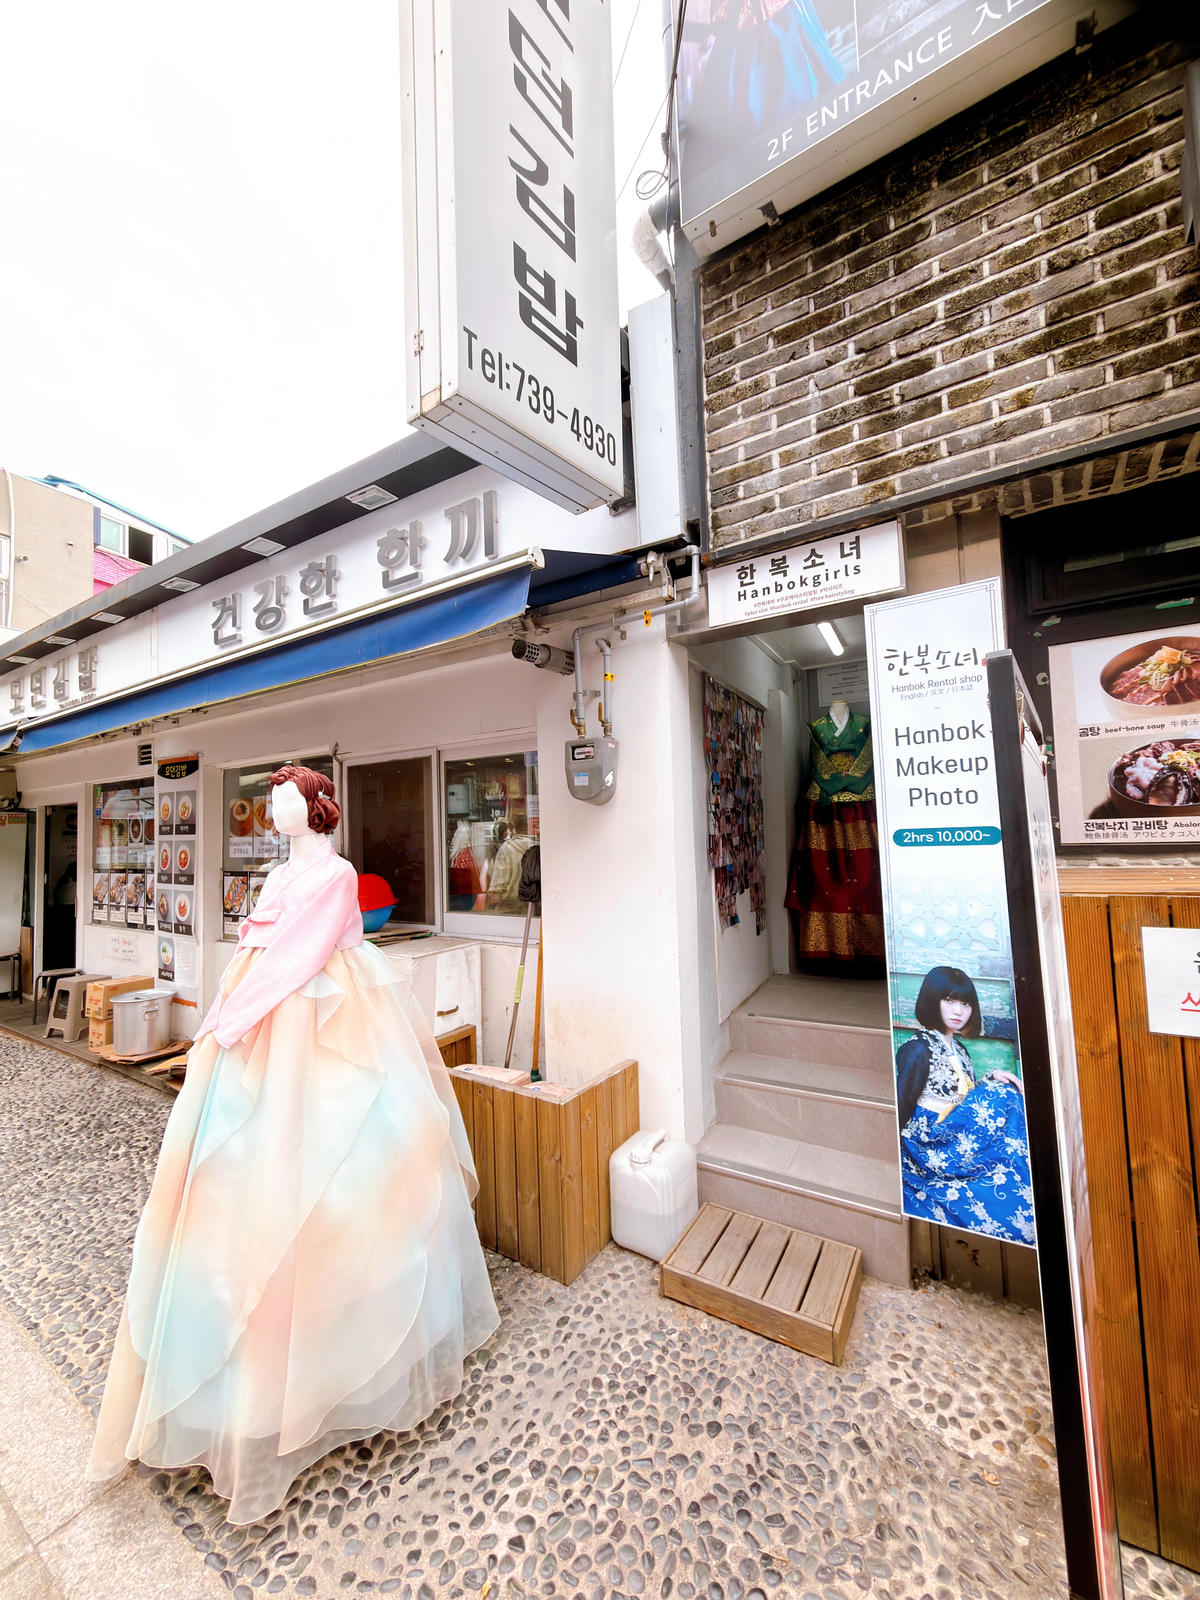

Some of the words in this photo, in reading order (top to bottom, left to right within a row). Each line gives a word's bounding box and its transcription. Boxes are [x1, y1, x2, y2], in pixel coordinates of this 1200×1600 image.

[767, 128, 793, 162] 2F
[806, 26, 953, 137] ENTRANCE
[462, 325, 616, 467] Tel:739-4930
[211, 554, 340, 647] 건강한
[376, 489, 499, 590] 한끼
[736, 535, 862, 588] 한복소녀
[737, 564, 862, 602] Hanbokgirls
[884, 644, 978, 676] 한복소녀
[891, 680, 925, 693] Hanbok
[927, 677, 957, 689] Rental
[959, 674, 983, 685] shop
[900, 690, 924, 700] English
[895, 720, 986, 747] Hanbok
[1078, 726, 1101, 738] 곰탕
[1105, 724, 1145, 734] beef-bone
[1147, 723, 1165, 732] soup
[896, 755, 989, 777] Makeup
[908, 787, 979, 807] Photo
[903, 832, 934, 843] 2hrs
[937, 831, 991, 843] 10,000~
[1083, 821, 1128, 832] 전복낙지
[1131, 819, 1168, 831] 갈비탕
